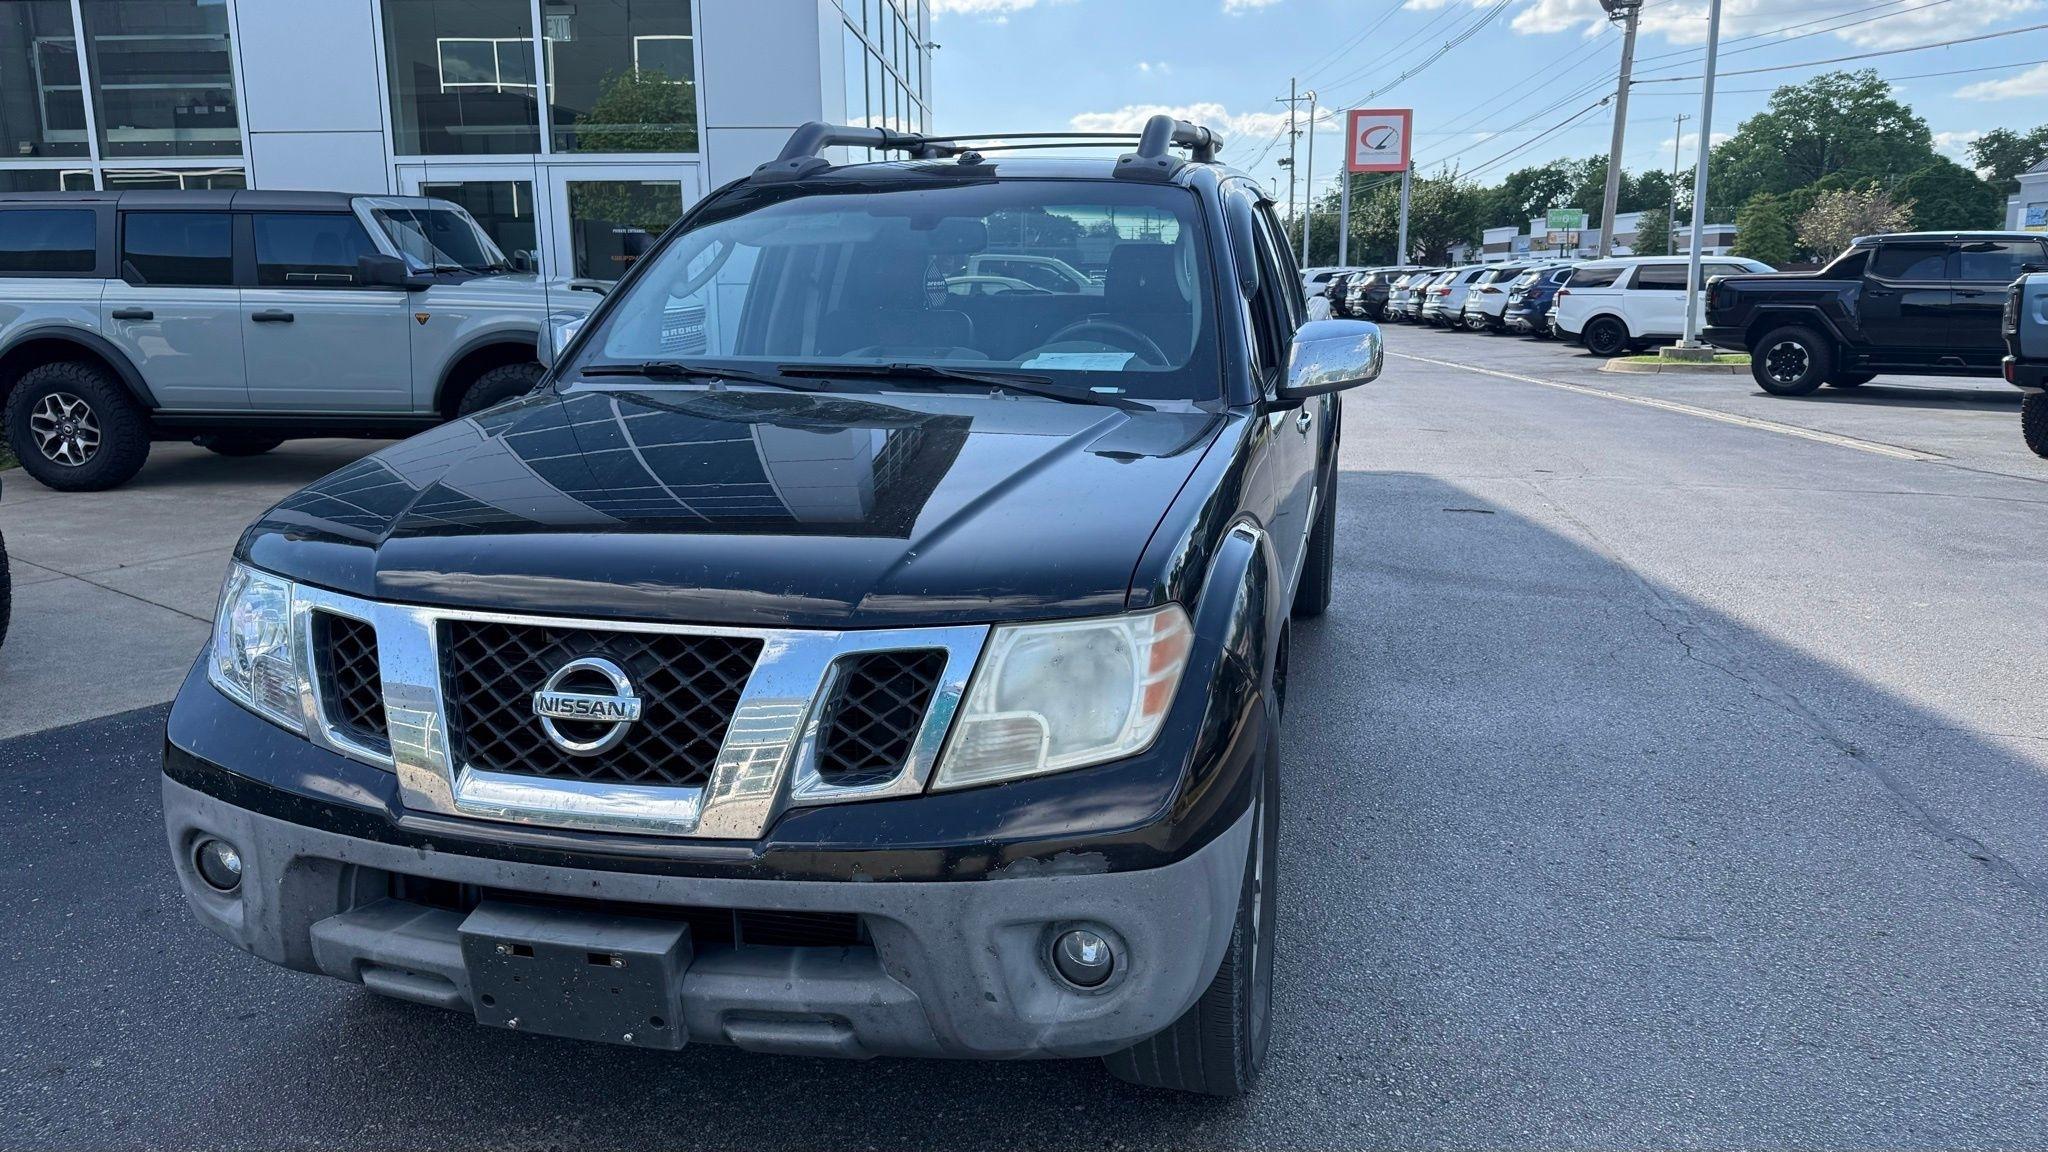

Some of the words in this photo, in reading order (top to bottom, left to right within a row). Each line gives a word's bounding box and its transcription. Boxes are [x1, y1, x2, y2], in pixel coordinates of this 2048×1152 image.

[546, 16, 571, 39] EXIT
[661, 324, 703, 338] BRONCO
[539, 696, 626, 717] NISSAN
